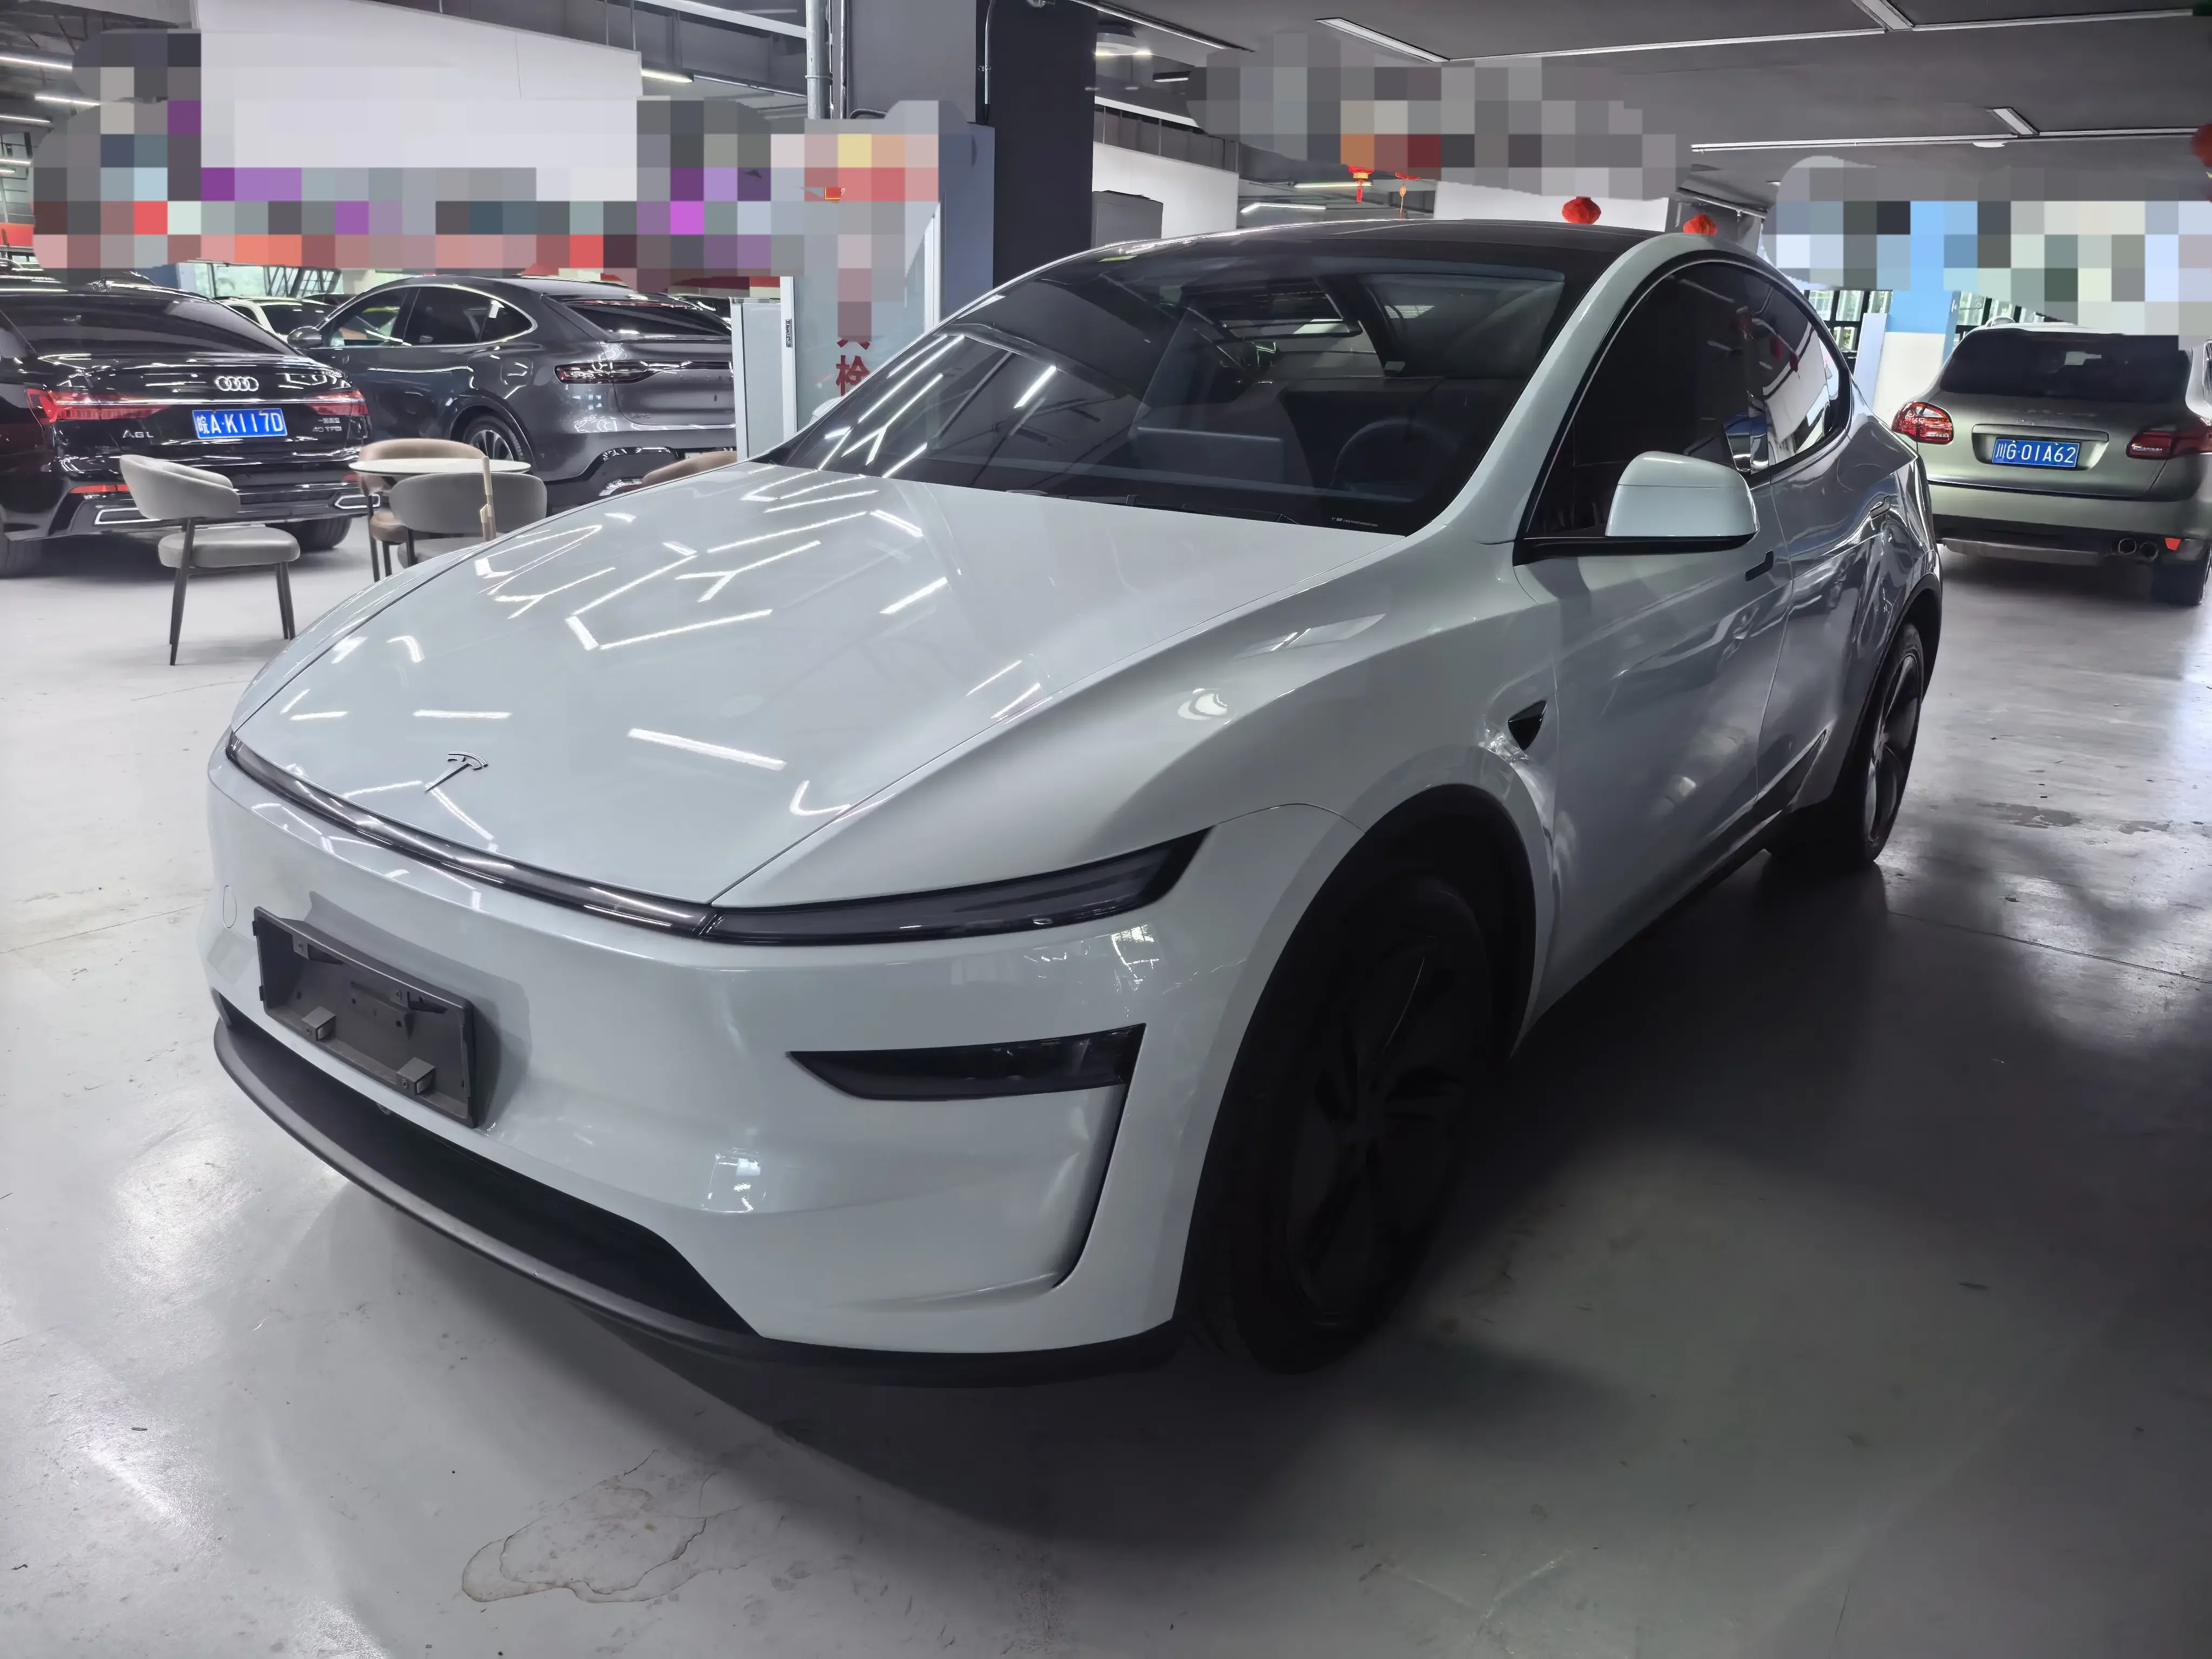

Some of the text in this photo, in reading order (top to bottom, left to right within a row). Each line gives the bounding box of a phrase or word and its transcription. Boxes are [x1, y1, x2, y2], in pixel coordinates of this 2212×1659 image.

[836, 339, 871, 397] 栓
[123, 430, 154, 438] A6L
[1995, 443, 2076, 463] 川G·01A62
